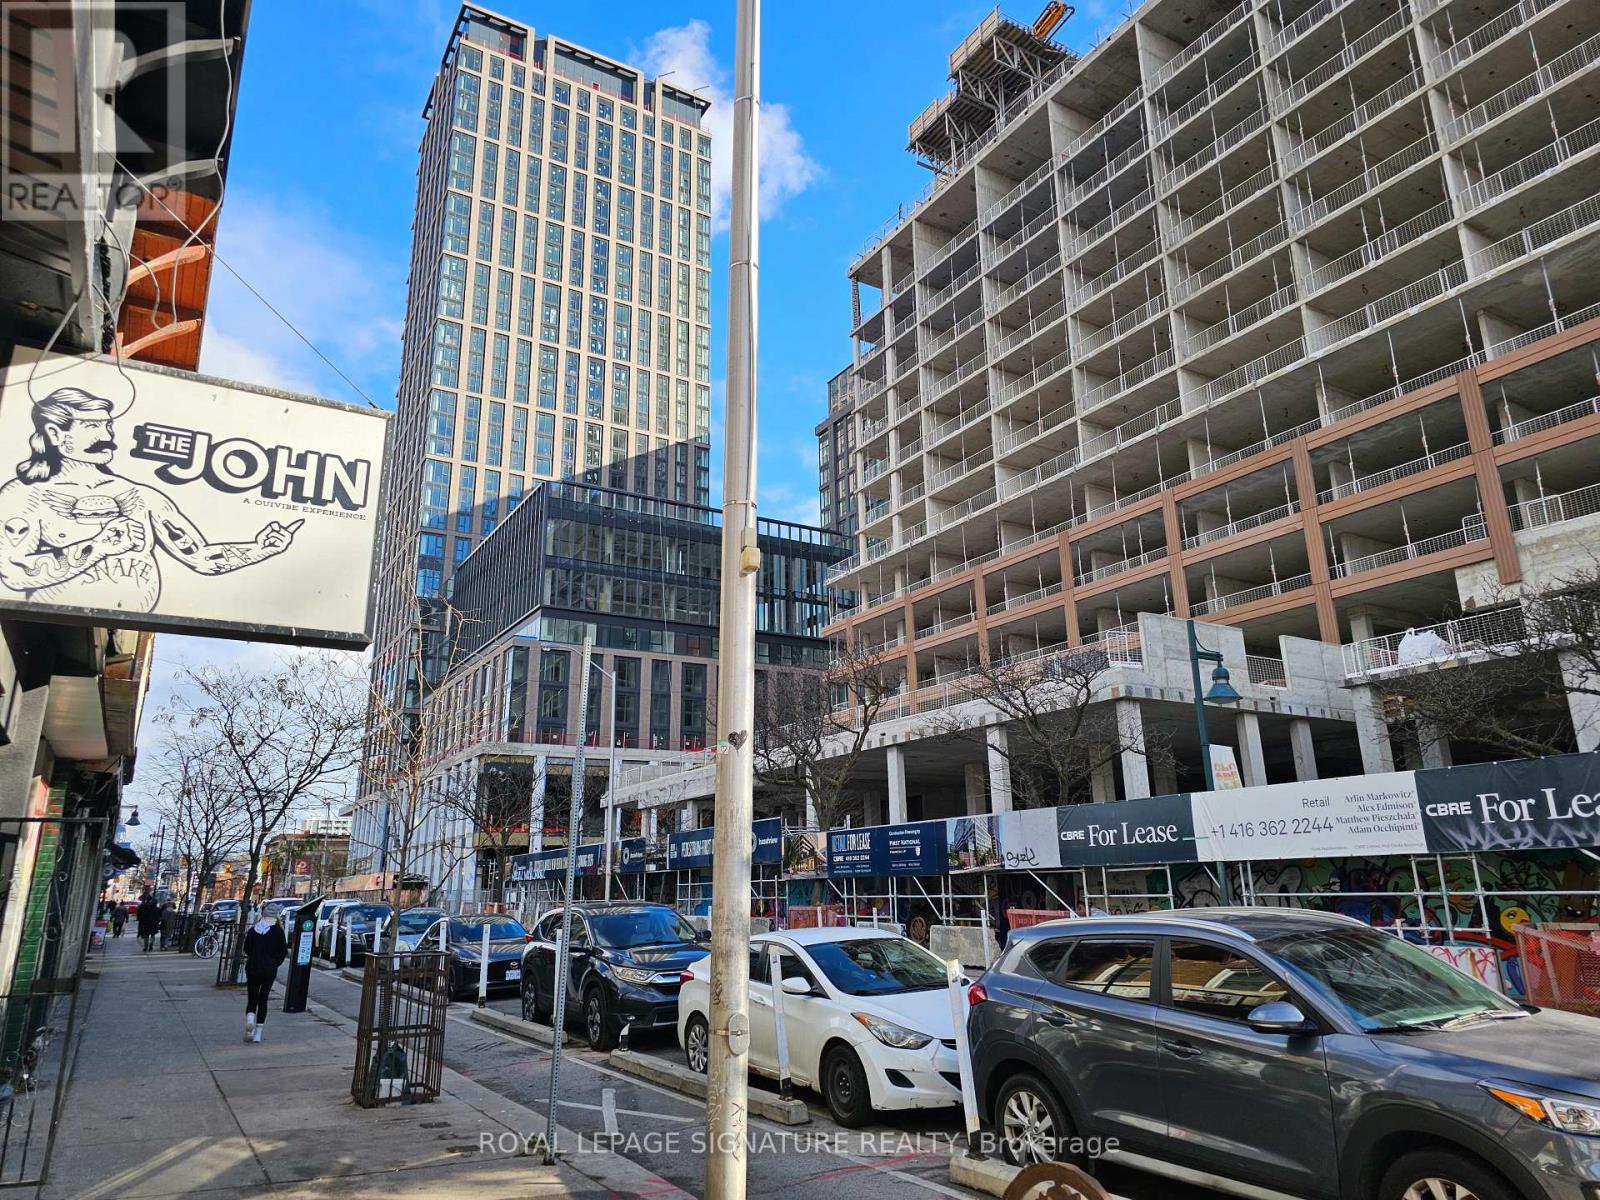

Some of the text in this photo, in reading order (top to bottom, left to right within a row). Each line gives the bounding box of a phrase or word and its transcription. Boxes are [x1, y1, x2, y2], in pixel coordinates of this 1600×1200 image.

[145, 430, 192, 453] THE
[155, 431, 371, 509] JOHN
[243, 497, 251, 505] A
[302, 505, 367, 521] EXPERIENCE
[80, 557, 153, 588] SNAKE
[1302, 797, 1330, 809] Retail
[1344, 795, 1365, 804] Arlin
[1425, 801, 1472, 816] CBRE
[1476, 792, 1535, 824] For
[1211, 816, 1333, 838] +1 416 362 2244
[1335, 816, 1369, 825] Matthew
[1349, 826, 1372, 834] Adam
[857, 832, 871, 850] LEASE
[1060, 822, 1178, 846] CBRE For Lease
